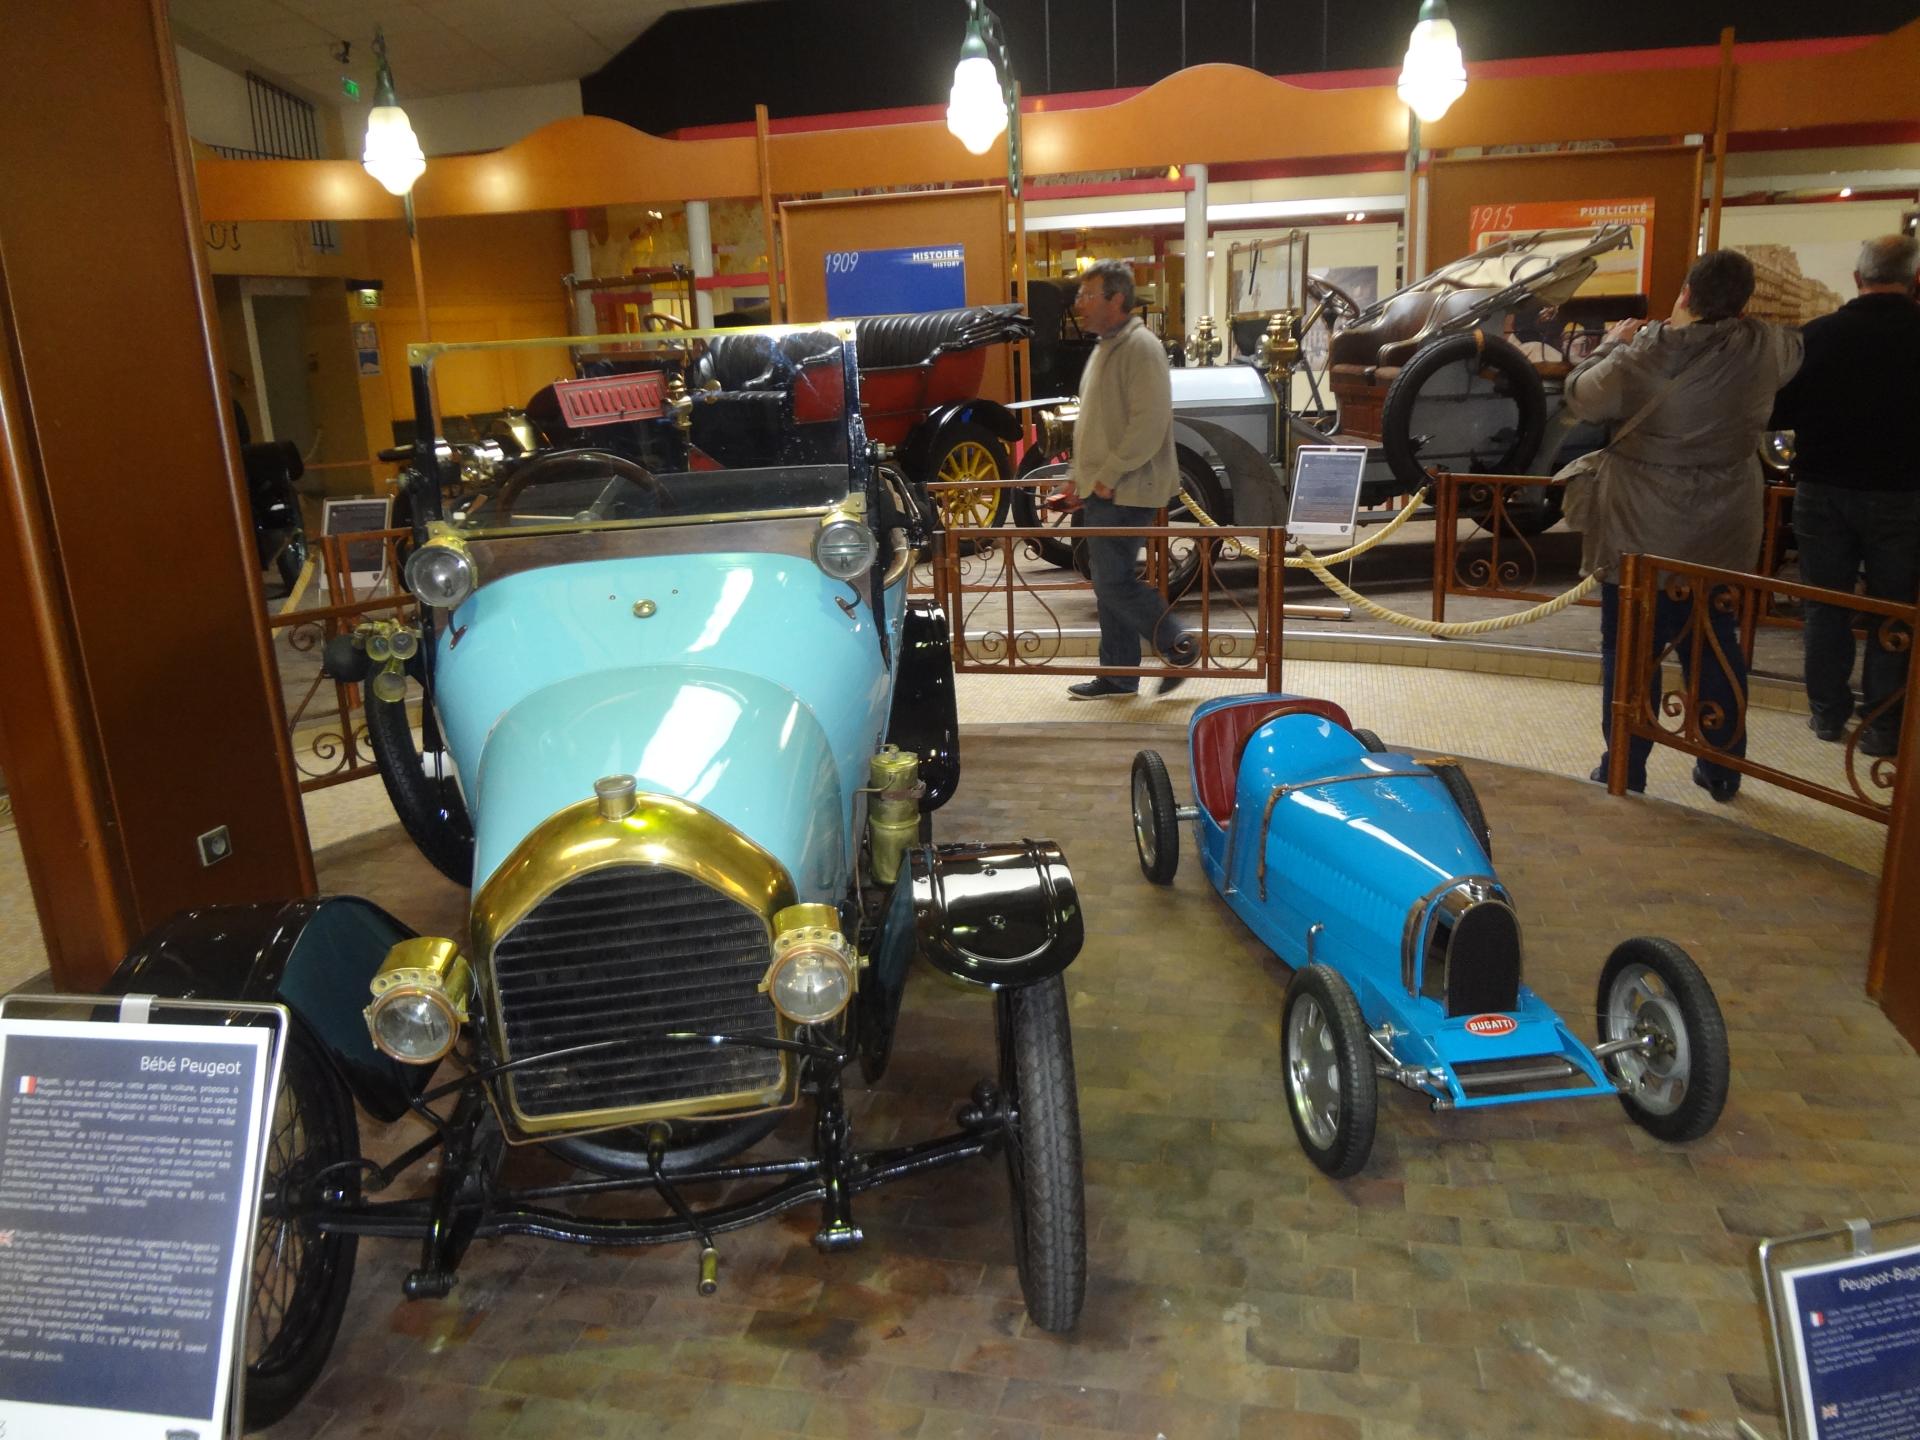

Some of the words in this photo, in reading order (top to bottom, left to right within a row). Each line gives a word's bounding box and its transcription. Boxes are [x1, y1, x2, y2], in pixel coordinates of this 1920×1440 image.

[1580, 202, 1648, 216] PUBLICITÉ
[1471, 206, 1516, 230] 1915
[912, 249, 960, 260] HISTOIRE
[825, 252, 858, 274] 1909
[932, 260, 960, 269] HISTORY
[1470, 1019, 1513, 1031] BUGATTI
[140, 1055, 177, 1071] Bébé
[179, 1057, 242, 1077] Peugeot
